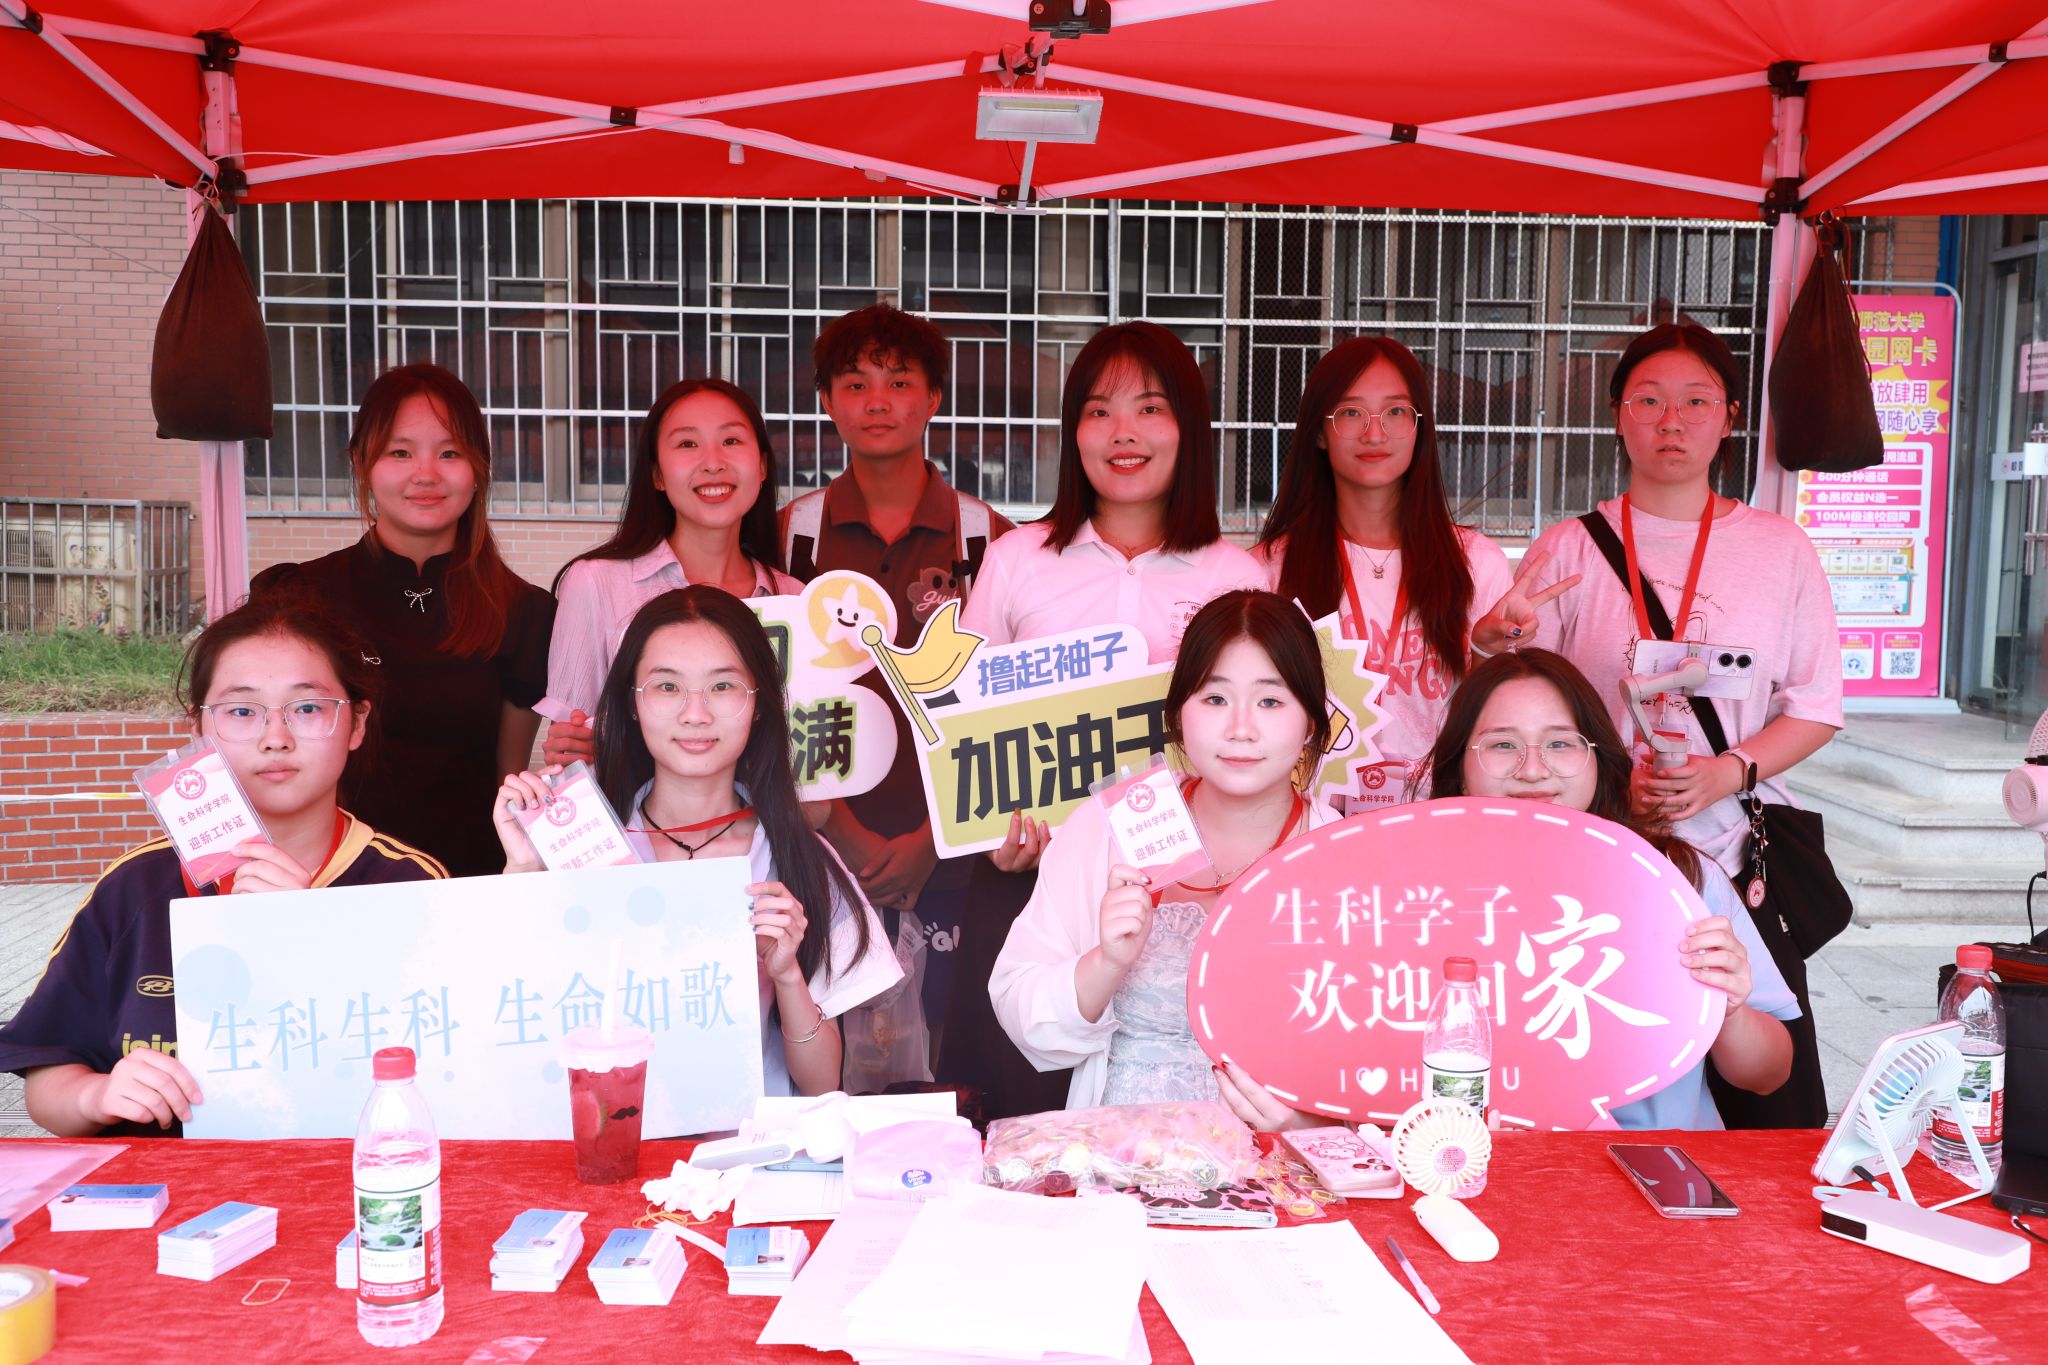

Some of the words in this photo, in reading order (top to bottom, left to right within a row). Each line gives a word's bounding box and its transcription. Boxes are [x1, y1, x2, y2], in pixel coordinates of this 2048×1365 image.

[1857, 311, 1925, 332] 师范大学
[1861, 336, 1938, 366] 园网卡
[1872, 382, 1927, 404] 放肆用
[1884, 451, 1917, 463] 用流量
[977, 631, 1127, 697] 撸起袖子
[790, 701, 853, 781] 满
[178, 793, 232, 827] 生命科学学院
[1127, 808, 1178, 837] 生命科学学院
[188, 814, 246, 851] 迎新工作证
[550, 817, 602, 854] 生命科学学院
[1134, 829, 1188, 862] 迎新工作证
[1268, 884, 1519, 948] 生科学子
[205, 985, 461, 1075] 生科生科
[494, 961, 737, 1048] 生命如歌
